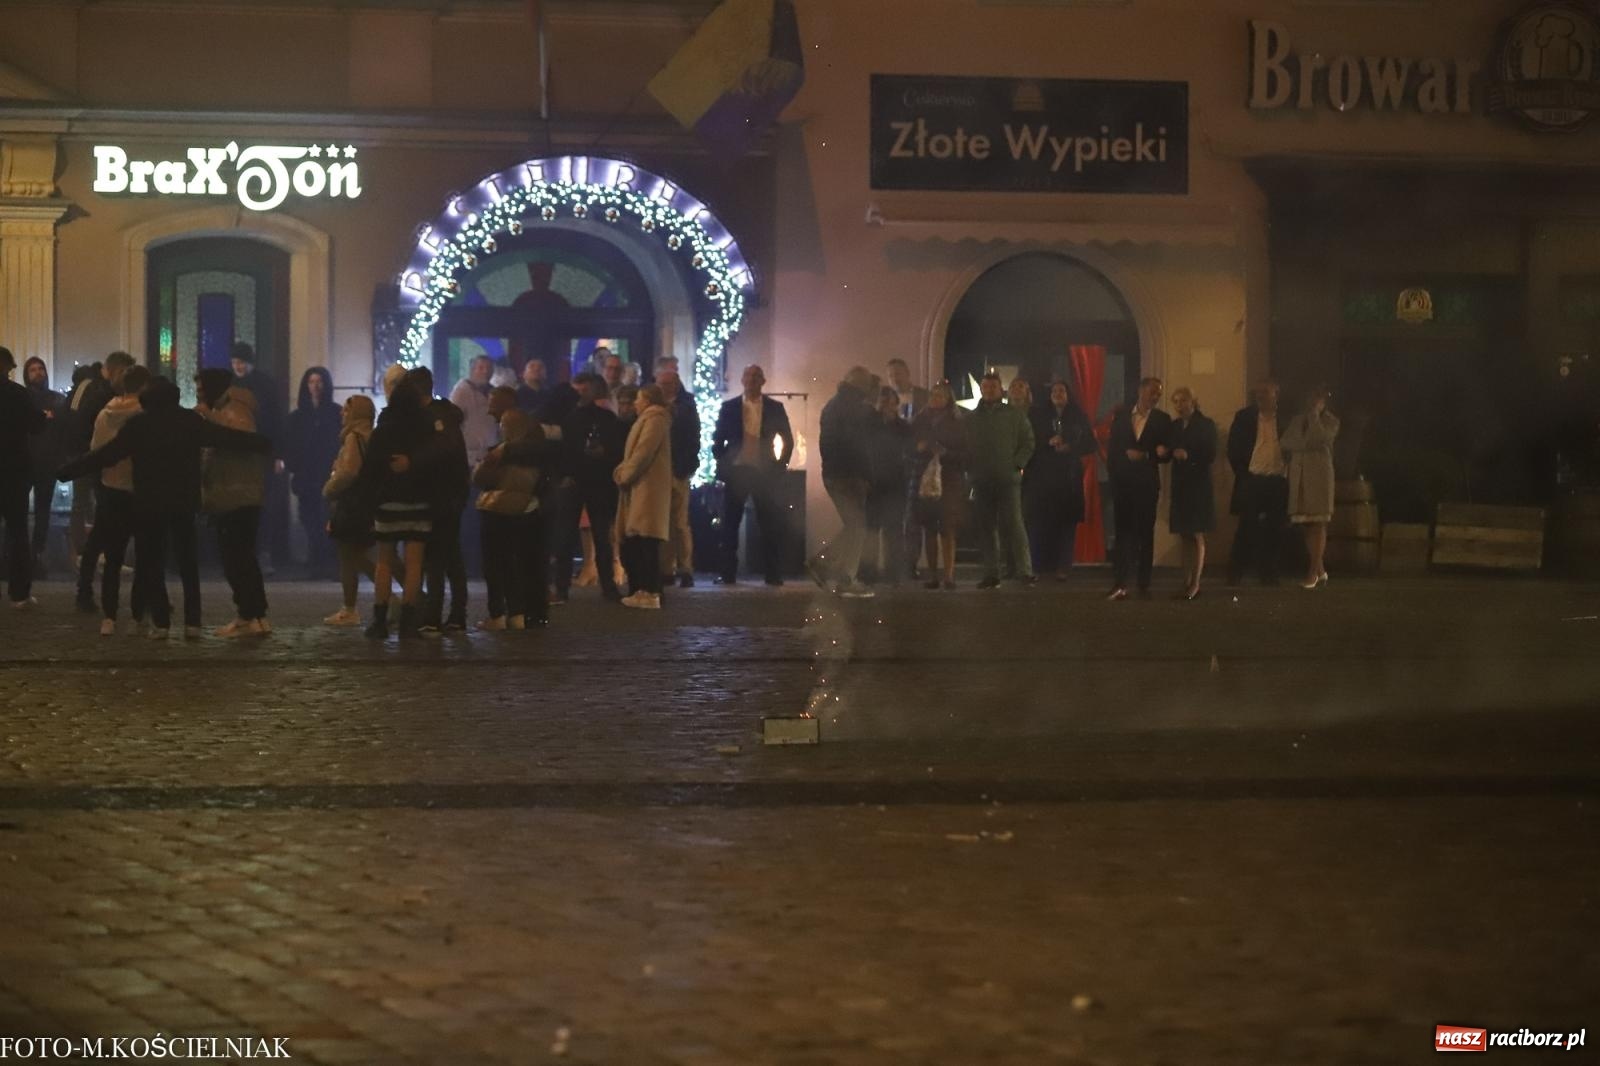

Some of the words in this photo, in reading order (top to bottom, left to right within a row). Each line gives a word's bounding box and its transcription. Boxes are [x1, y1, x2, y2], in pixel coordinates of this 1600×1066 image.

[1248, 19, 1481, 113] Browar
[888, 117, 992, 160] Złote
[1002, 122, 1168, 173] Wypieki
